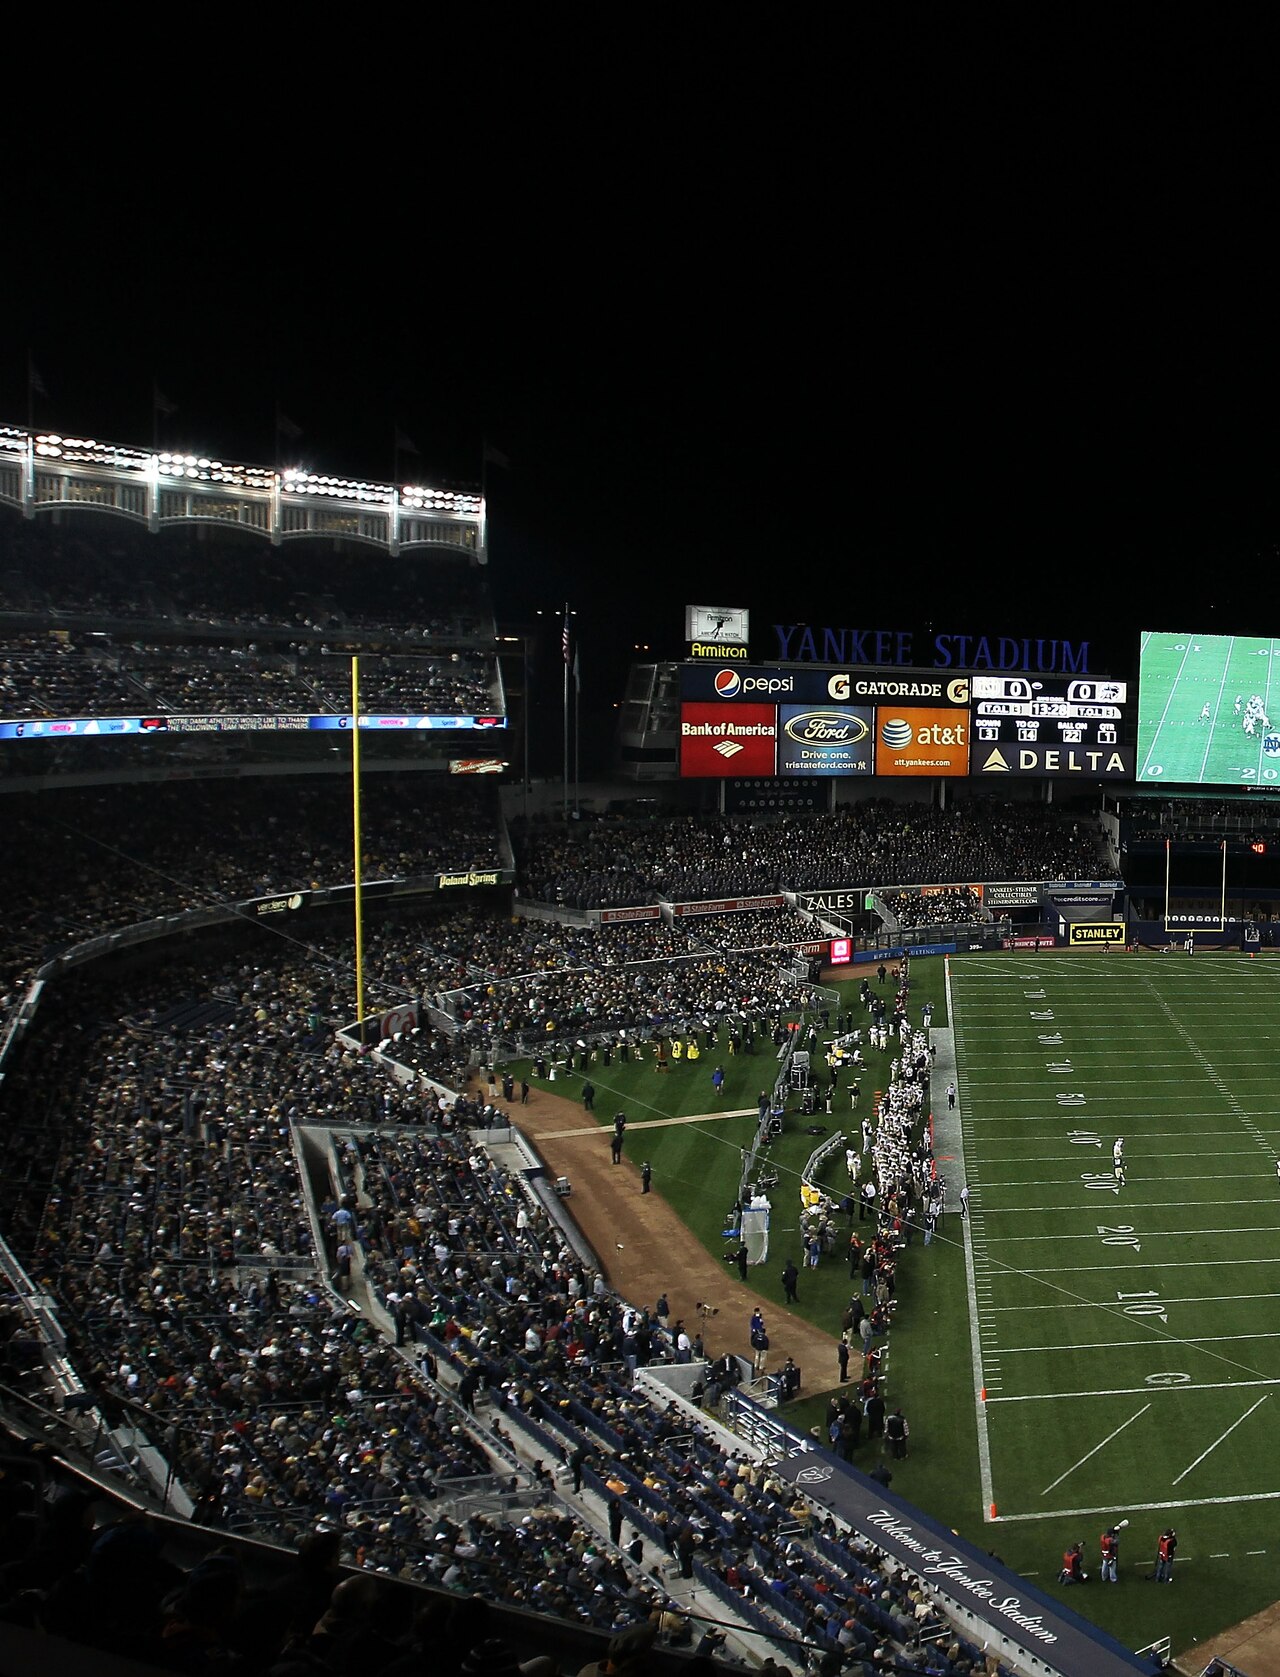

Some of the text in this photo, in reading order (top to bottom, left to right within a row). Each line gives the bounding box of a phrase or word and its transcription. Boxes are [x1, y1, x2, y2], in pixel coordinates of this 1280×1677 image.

[691, 642, 747, 658] Armitron
[773, 624, 1090, 674] YANKEE STADIUM
[743, 676, 794, 694] pepsi
[828, 674, 968, 703] G GATORADE G
[1010, 682, 1022, 697] 0
[1079, 685, 1091, 699] 0
[1032, 703, 1068, 716] 13:28
[682, 723, 775, 736] Bank of America
[804, 718, 848, 739] Ford
[975, 719, 1001, 727] DOWN
[1015, 720, 1026, 728] TO
[1057, 722, 1075, 730] BALL
[1099, 723, 1115, 731] QTR
[917, 724, 965, 745] at&t
[1022, 730, 1035, 739] 14
[1065, 731, 1079, 741] 22
[801, 751, 827, 759] Drive
[1019, 749, 1125, 773] DELTA
[785, 761, 857, 770] tristateford.com
[894, 759, 950, 768] att.yankees.com
[1252, 843, 1264, 853] 40
[439, 873, 496, 889] Poland Spring
[806, 894, 854, 911] ZALES
[1054, 895, 1109, 903] freecreditscore.com
[689, 905, 707, 913] State
[1075, 928, 1120, 939] STANLEY
[1080, 1173, 1118, 1189] 30
[1096, 1225, 1140, 1245] 20
[1116, 1290, 1165, 1315] 10
[866, 1509, 1059, 1644] Welcome to Yankee Stadium
